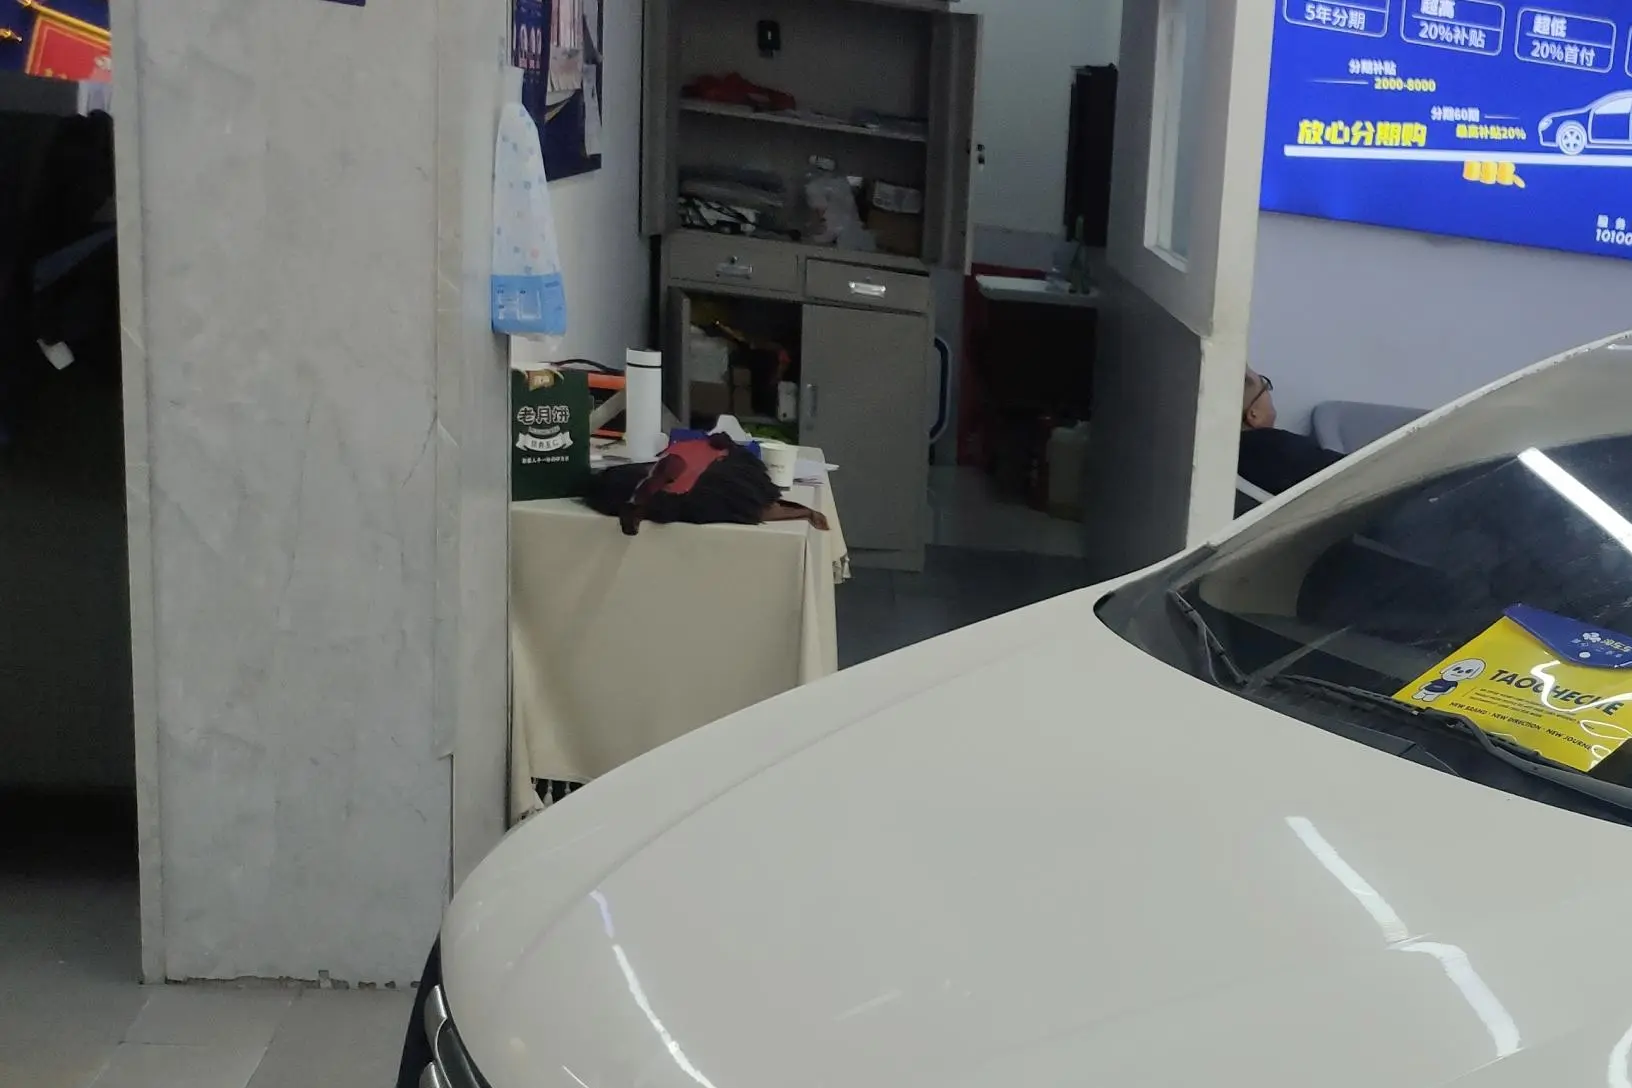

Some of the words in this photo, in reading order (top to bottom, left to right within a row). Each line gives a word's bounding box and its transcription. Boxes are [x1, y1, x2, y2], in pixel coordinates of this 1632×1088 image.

[1304, 3, 1366, 31] 5年分期
[1532, 13, 1567, 38] 超低
[1419, 20, 1487, 49] 20%补贴
[1530, 39, 1596, 68] 20%首付
[1297, 119, 1428, 147] 放心分期购
[517, 405, 570, 425] 老月饼
[1491, 712, 1508, 722] NEW
[1546, 728, 1563, 739] NEW
[1563, 733, 1600, 752] JOURNE
